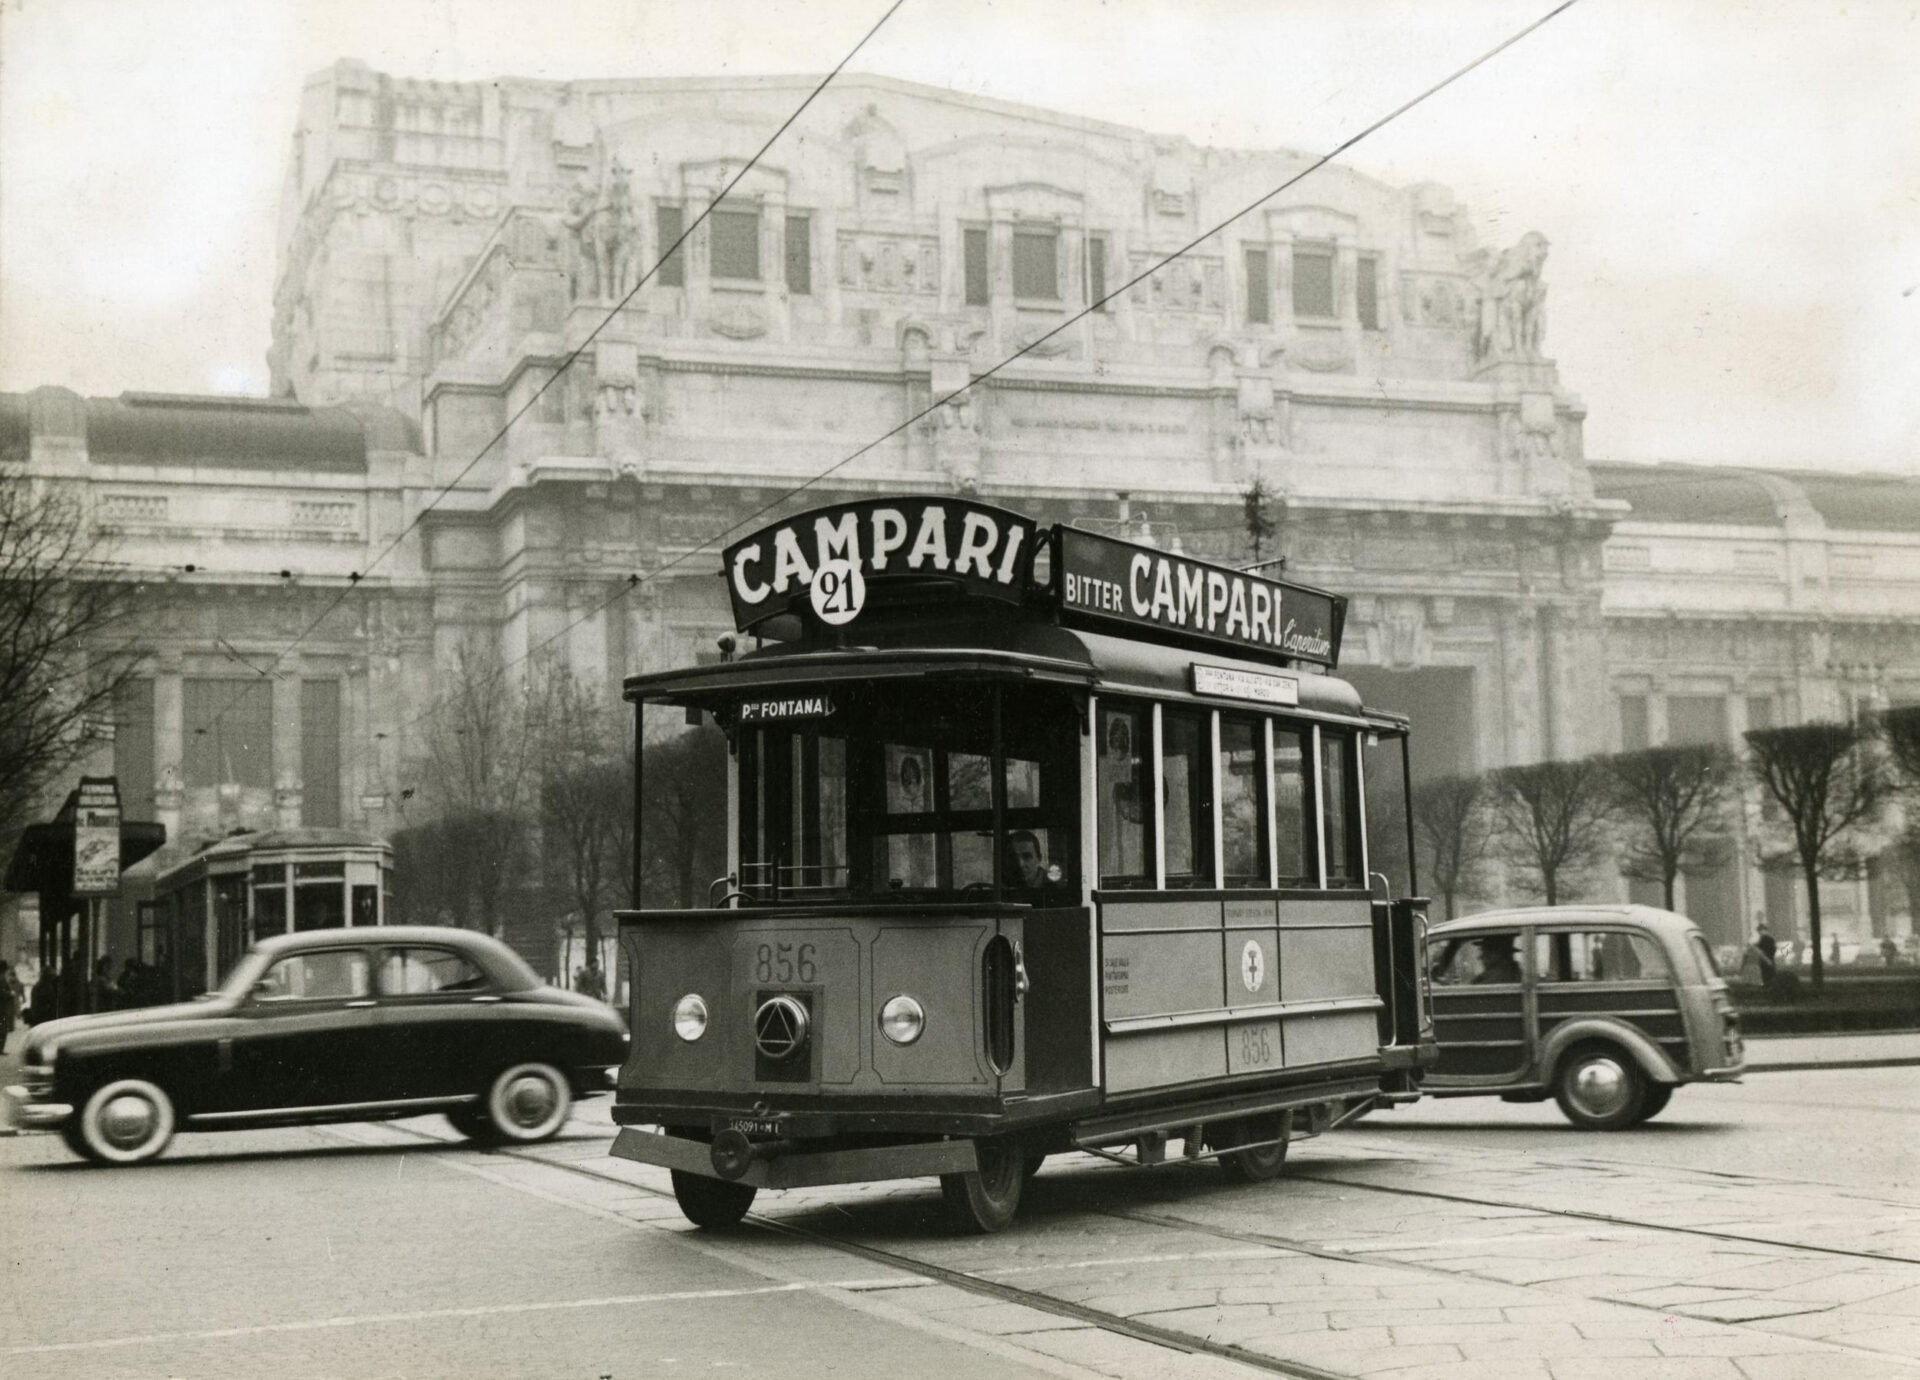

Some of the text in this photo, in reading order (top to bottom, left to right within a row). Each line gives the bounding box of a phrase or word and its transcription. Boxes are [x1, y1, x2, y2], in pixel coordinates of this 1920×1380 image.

[733, 505, 1025, 603] CAMPARI
[819, 569, 859, 614] 21
[1065, 572, 1124, 613] BITTER
[1130, 552, 1284, 645] CAMPARI
[761, 698, 823, 718] FONTANA
[756, 943, 817, 983] 856
[1242, 1027, 1271, 1064] 856
